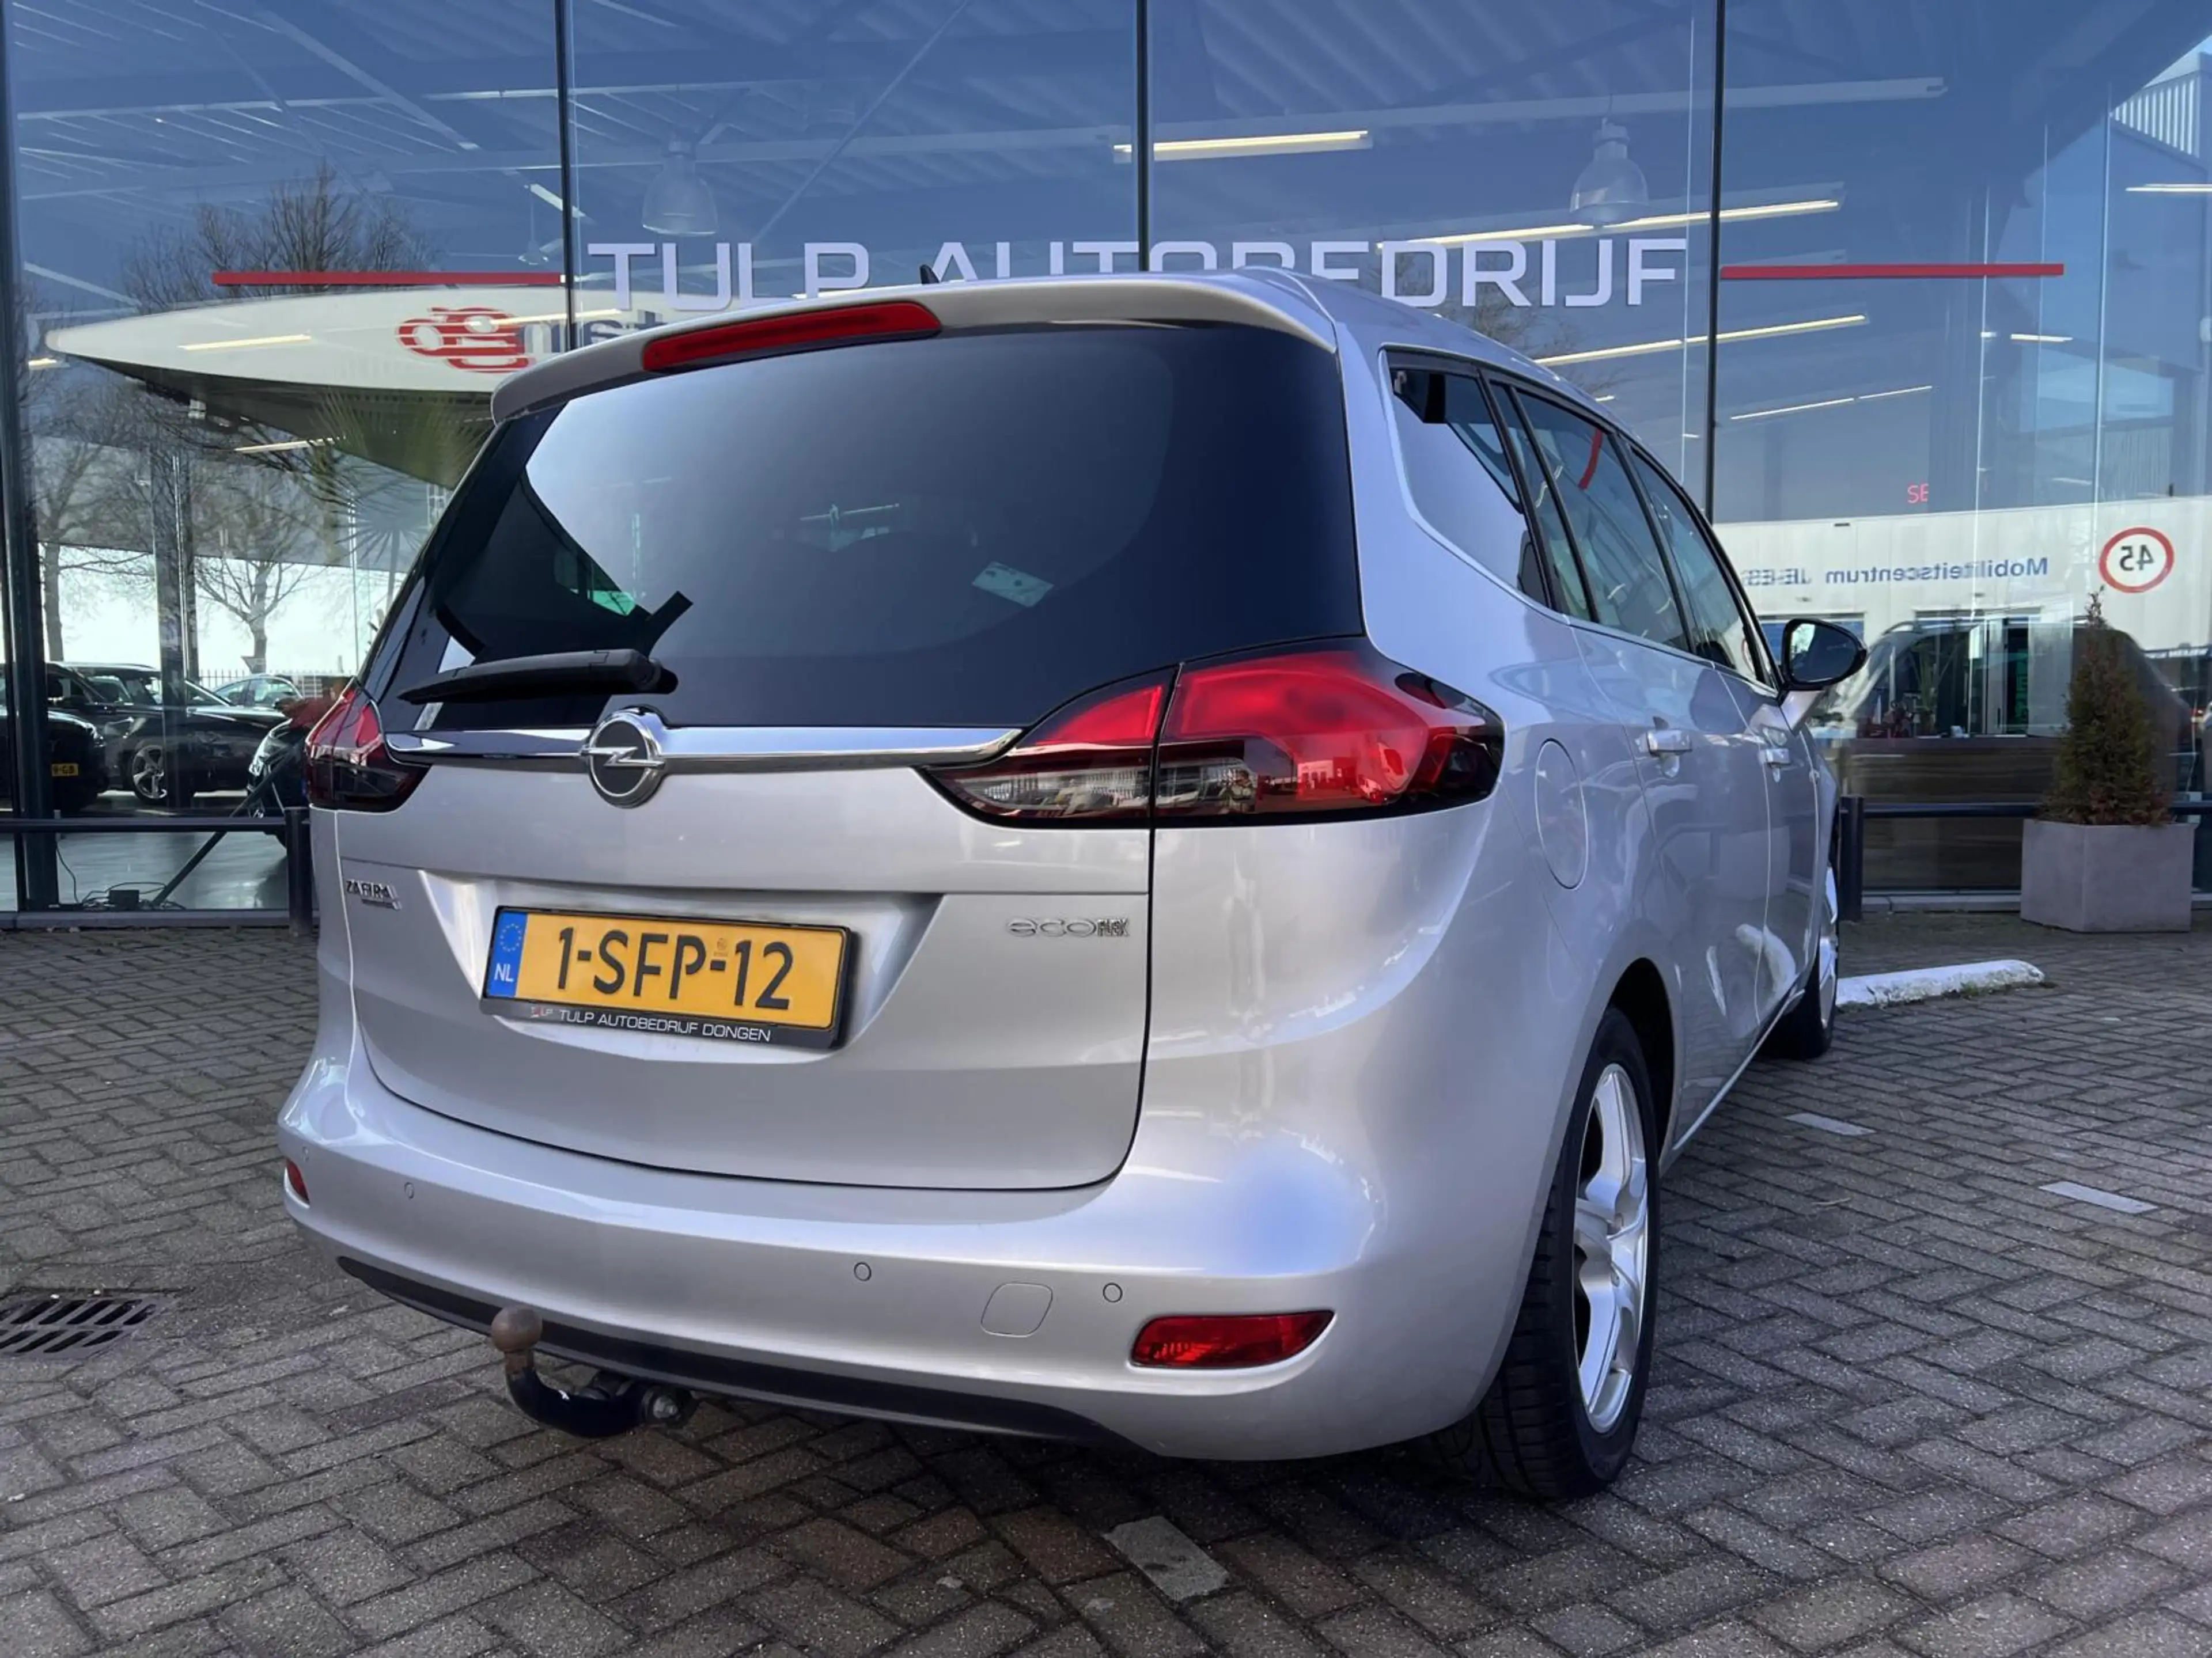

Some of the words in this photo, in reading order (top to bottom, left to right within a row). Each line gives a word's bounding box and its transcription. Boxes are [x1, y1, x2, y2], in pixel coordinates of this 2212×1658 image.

[588, 242, 869, 310] TULP
[494, 962, 514, 983] NL
[558, 927, 793, 1010] 1-SFP-12
[559, 1009, 594, 1023] TULP
[597, 1014, 698, 1035] AUTOBEDRIJF
[702, 1023, 771, 1042] DONGEN
